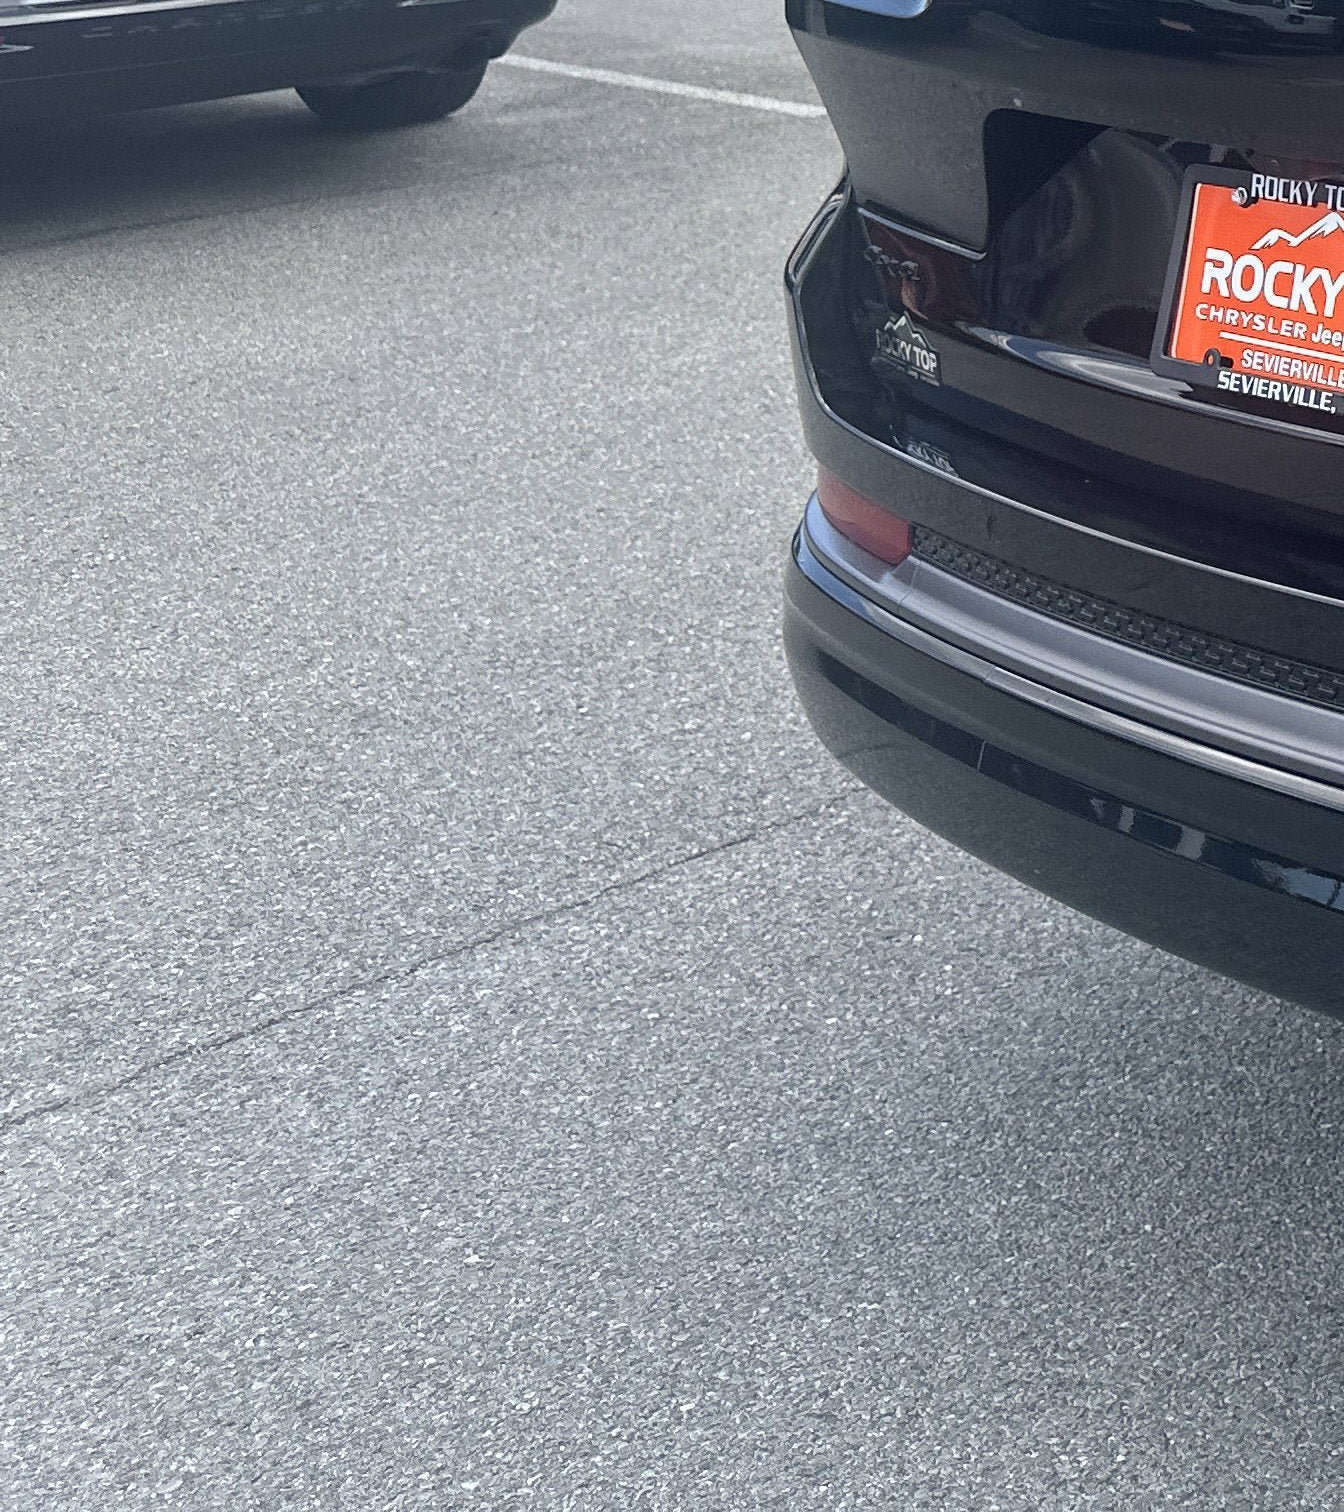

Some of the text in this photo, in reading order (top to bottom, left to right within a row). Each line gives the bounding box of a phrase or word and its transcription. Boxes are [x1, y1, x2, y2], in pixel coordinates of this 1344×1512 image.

[1251, 173, 1318, 206] ROCKY
[1195, 302, 1307, 340] CHRYSLER
[912, 345, 938, 373] TOP
[1217, 371, 1337, 416] SEVIERVILLE,
